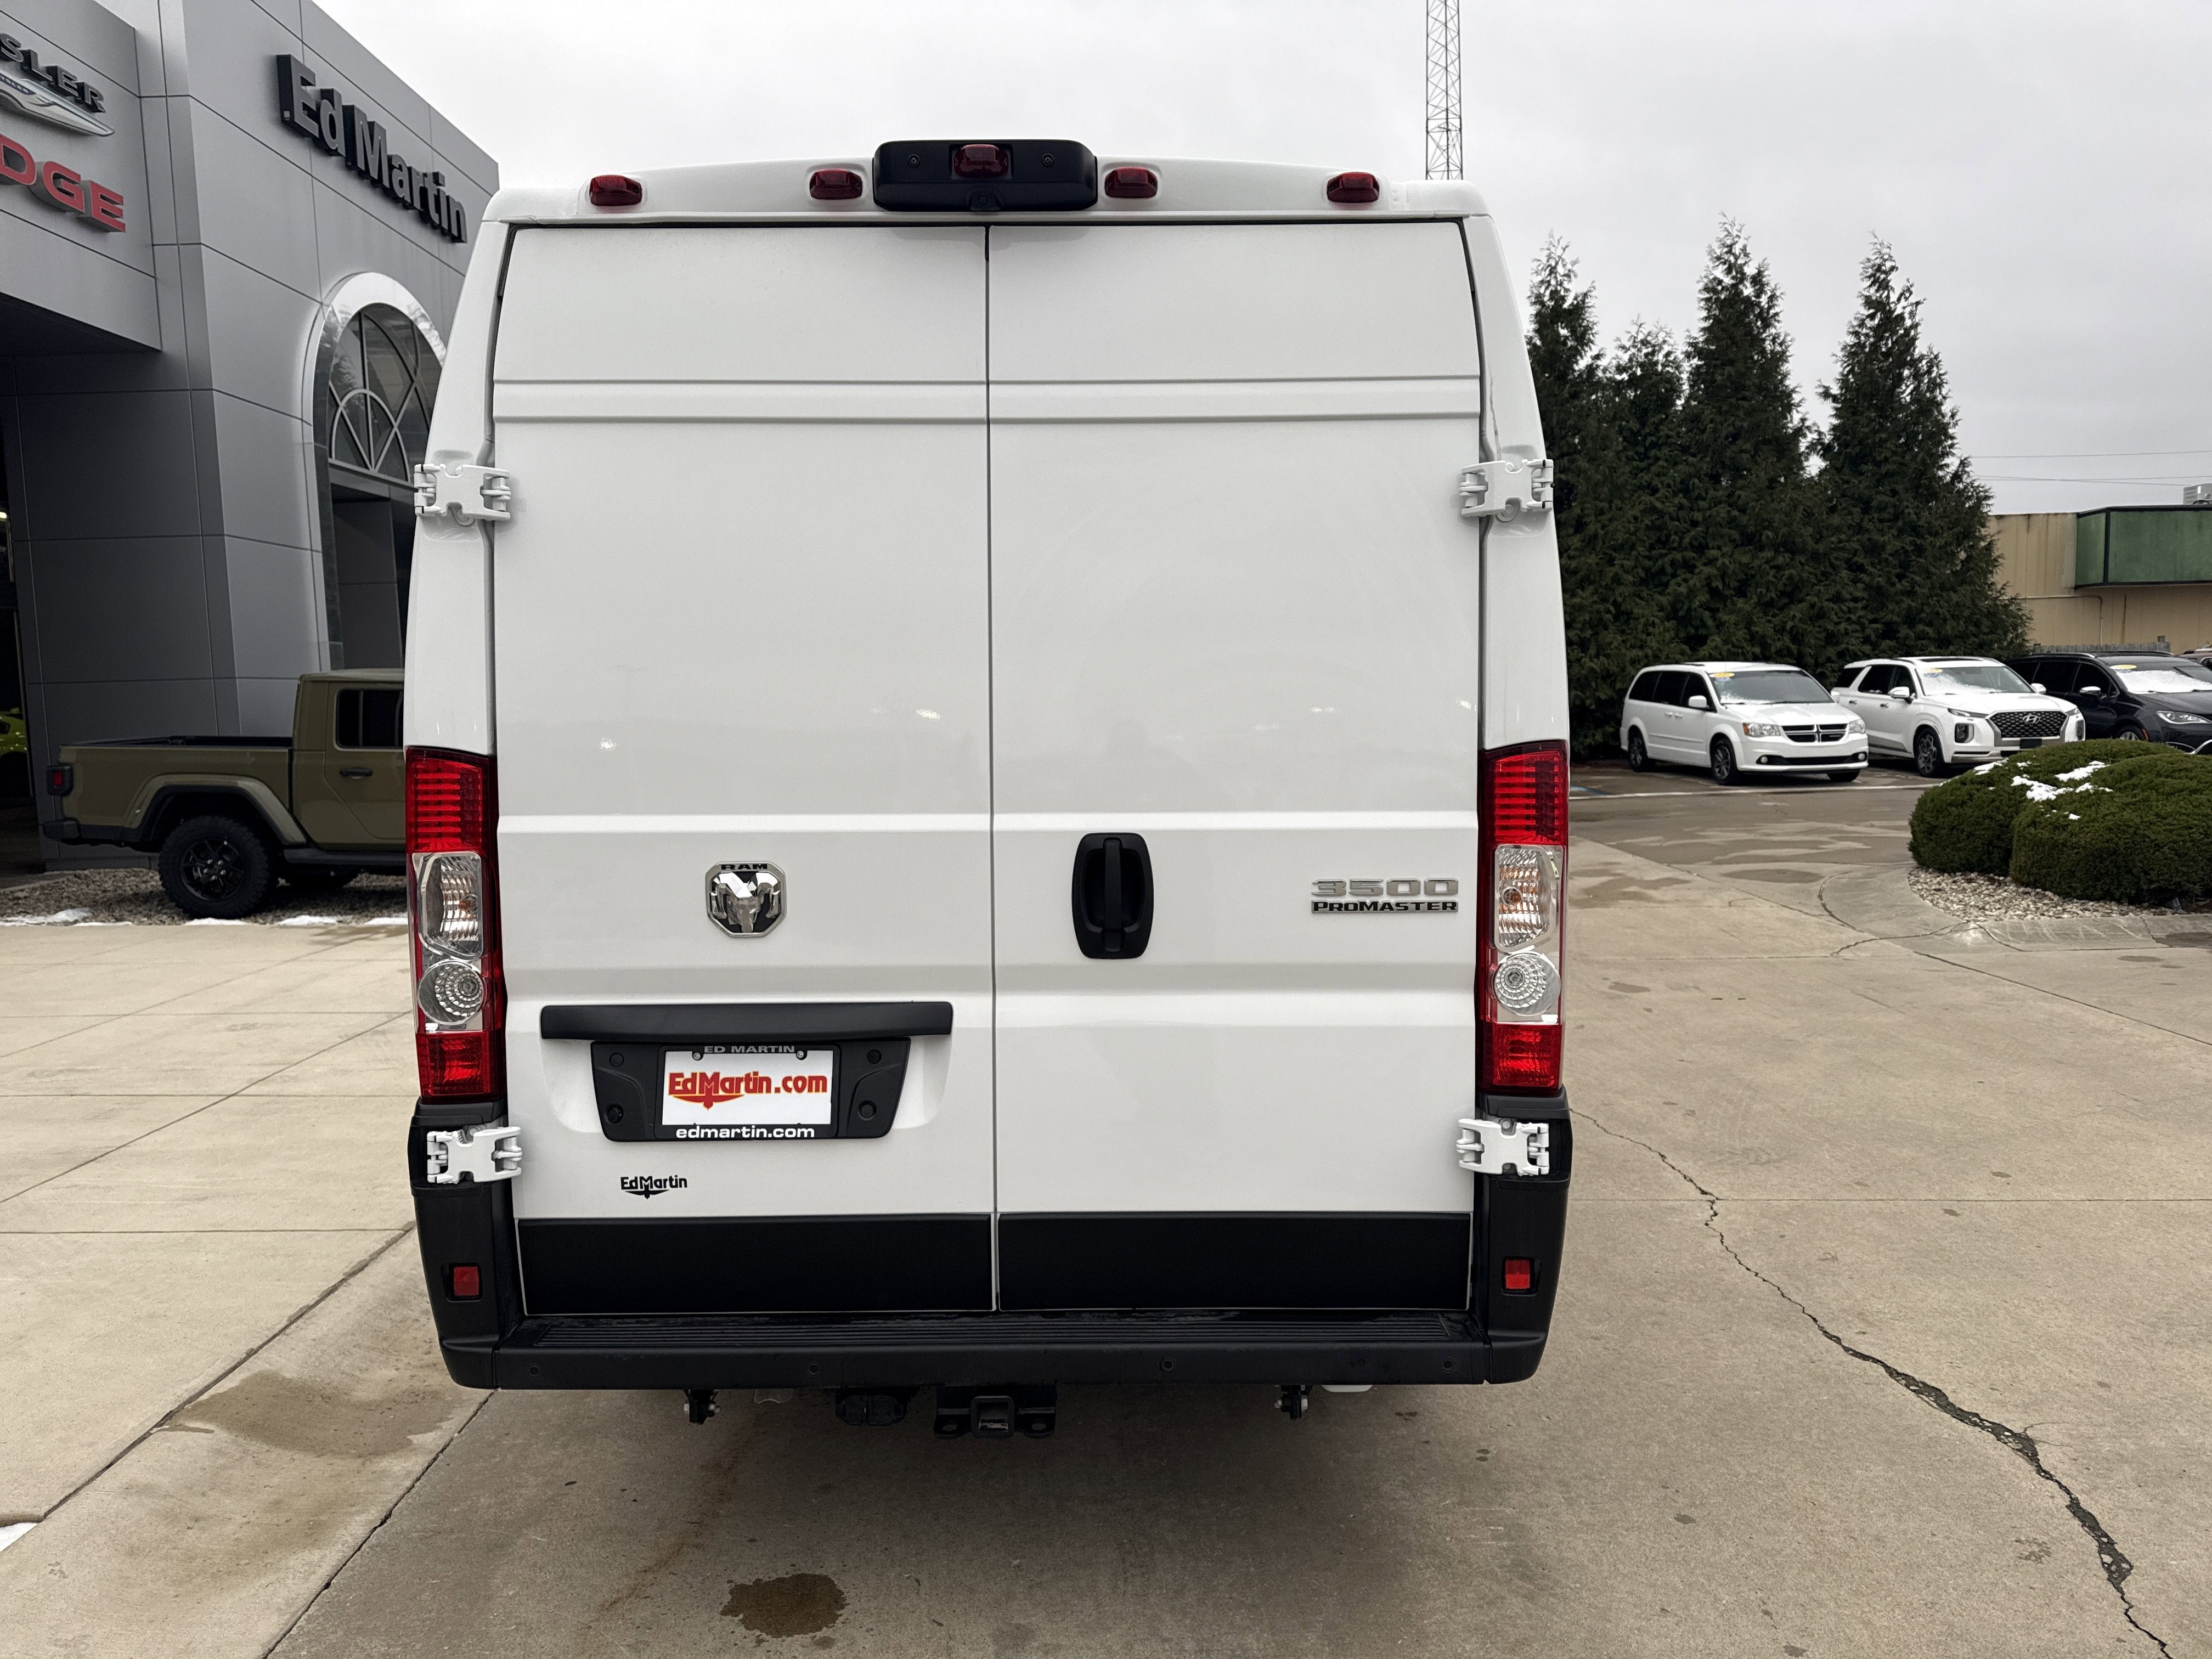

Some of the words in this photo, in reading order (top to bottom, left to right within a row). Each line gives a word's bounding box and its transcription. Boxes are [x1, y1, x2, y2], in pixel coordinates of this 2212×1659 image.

[276, 54, 346, 157] Ed
[343, 104, 467, 244] Martin
[1312, 878, 1458, 896] 3500
[668, 1071, 828, 1097] EdMartin.com
[676, 1125, 815, 1138] edmartin.com
[620, 1175, 687, 1190] EdMartin
